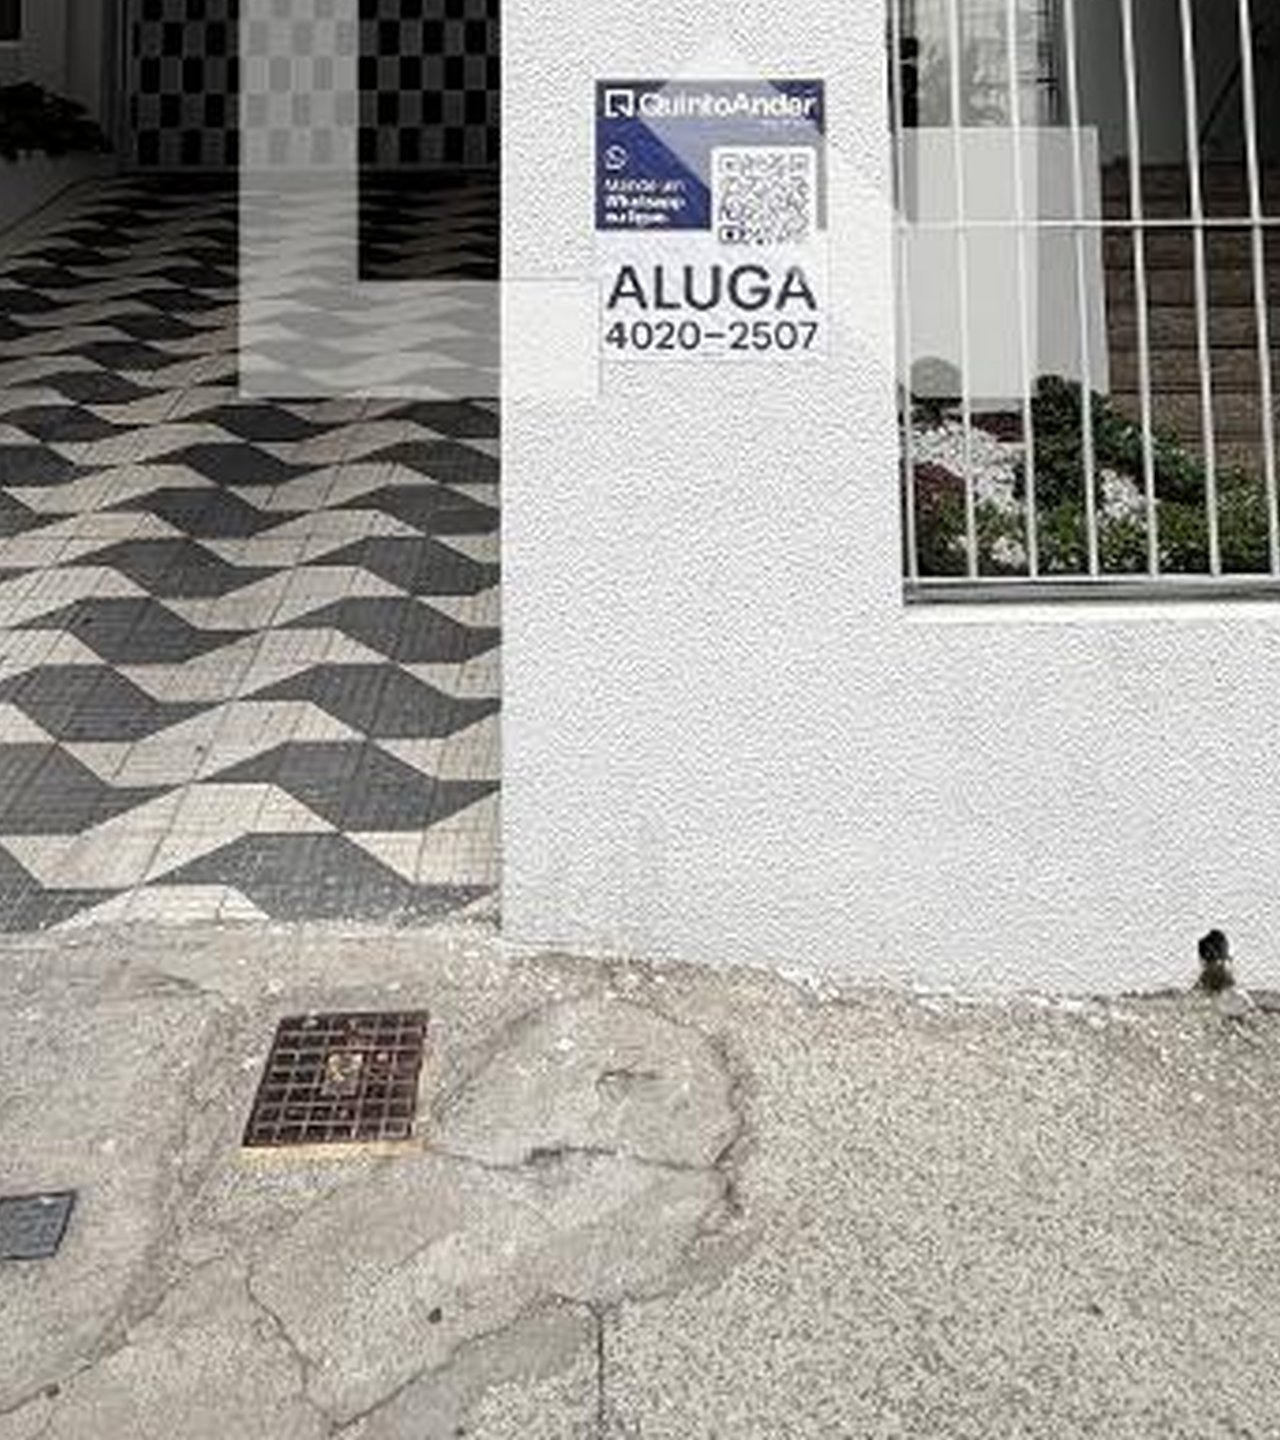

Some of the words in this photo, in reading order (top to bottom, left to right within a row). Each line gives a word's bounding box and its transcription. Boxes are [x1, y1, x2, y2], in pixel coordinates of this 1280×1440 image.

[638, 91, 818, 117] QuintoAndar
[607, 264, 817, 310] ALUGA
[605, 320, 819, 351] 4020-2507
